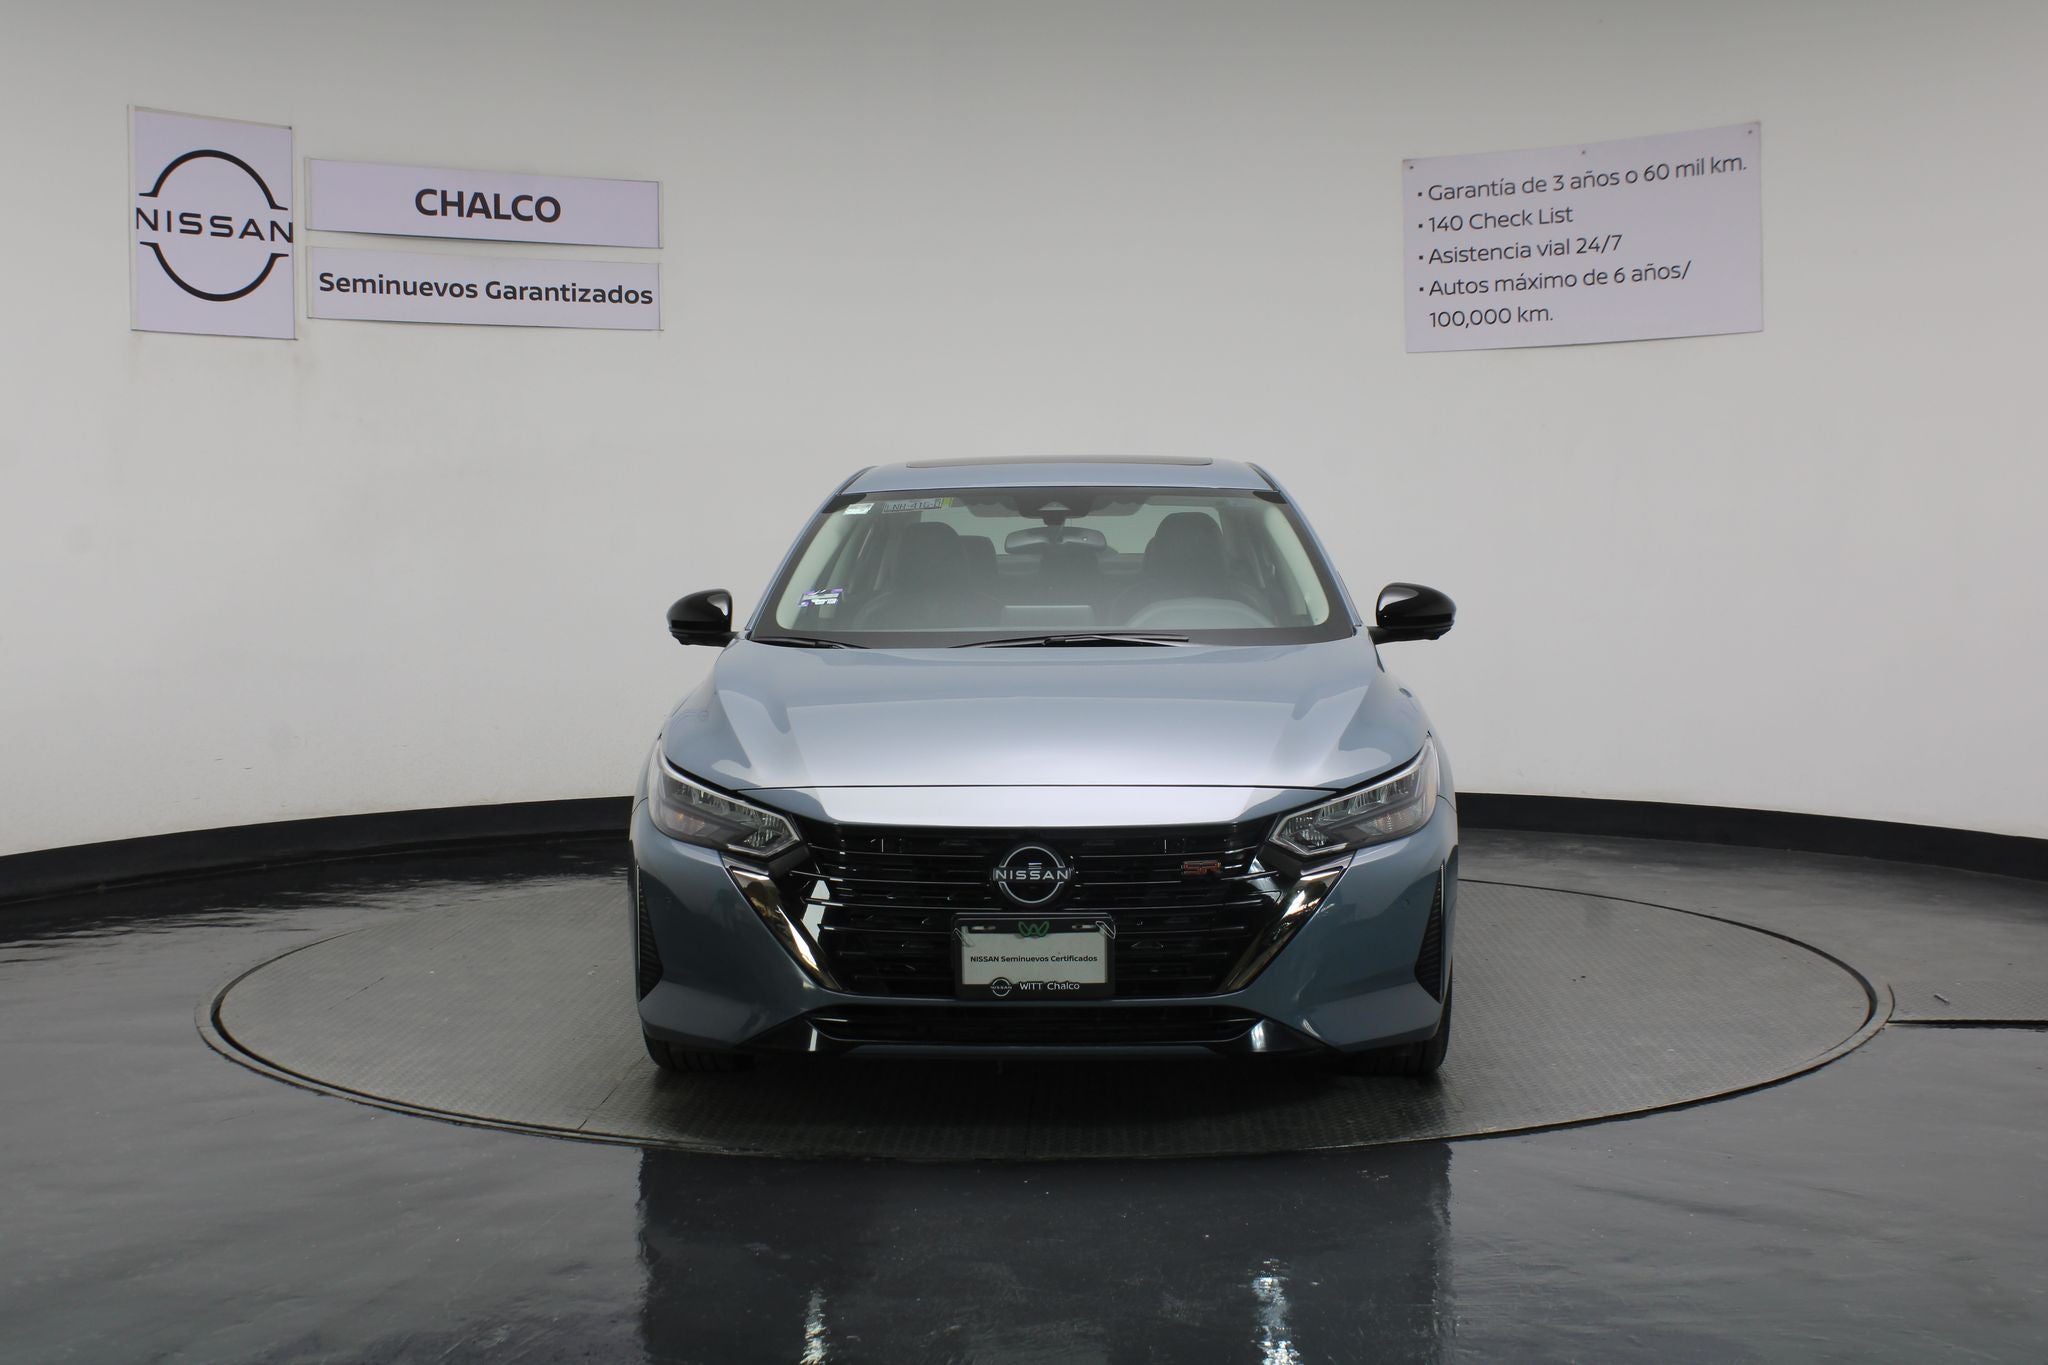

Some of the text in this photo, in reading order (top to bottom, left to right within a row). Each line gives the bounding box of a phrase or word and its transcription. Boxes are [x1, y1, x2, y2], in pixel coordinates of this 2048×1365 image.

[1429, 157, 1746, 200] Garantía de 3 años o 60 mil km.
[415, 189, 561, 223] CHALCO
[1429, 207, 1573, 232] 140 Check List
[135, 207, 293, 243] NISSAN
[1429, 235, 1622, 264] Asistencia vial 24/7
[320, 273, 652, 304] Seminuevos Garantizados
[1429, 261, 1691, 296] Autos máximo de 6 años/
[1430, 307, 1553, 328] 100,000 km.
[995, 870, 1069, 880] NISSAN
[970, 955, 1098, 963] NISSAN Seminuevos Certificados
[1019, 981, 1080, 991] WITT Chalco
